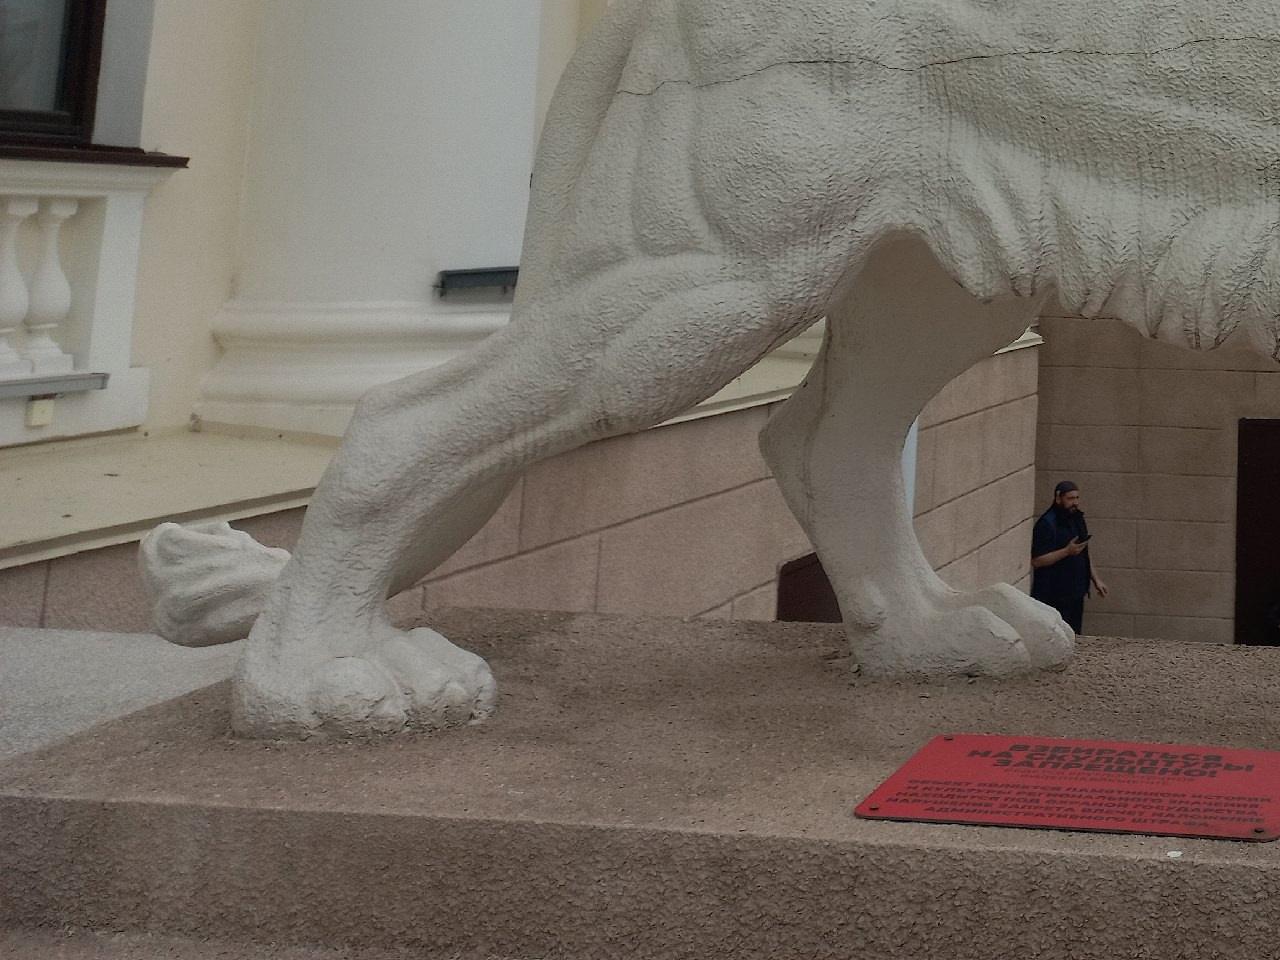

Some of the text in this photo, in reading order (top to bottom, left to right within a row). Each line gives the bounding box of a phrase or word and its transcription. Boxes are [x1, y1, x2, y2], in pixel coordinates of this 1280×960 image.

[1009, 744, 1222, 761] ВЗБИРАТЬСЯ
[968, 750, 1254, 772] НА СКУЛЬПТУРЫ
[993, 759, 1217, 777] ЗАПРЕЩЕНО!
[885, 797, 993, 807] НАРУШЕНИЕ
[895, 792, 1000, 801] НАХОДИТСЯ
[922, 786, 1011, 795] КУЛЬТУРЫ
[1015, 791, 1163, 804] РЕГИОНАЛЬНОГО
[1066, 787, 1186, 797] ПАМЯТНИКОМ
[1191, 794, 1271, 803] ИСТОРИИ
[923, 807, 1126, 822] АДМИНИСТРАТИВНОГО
